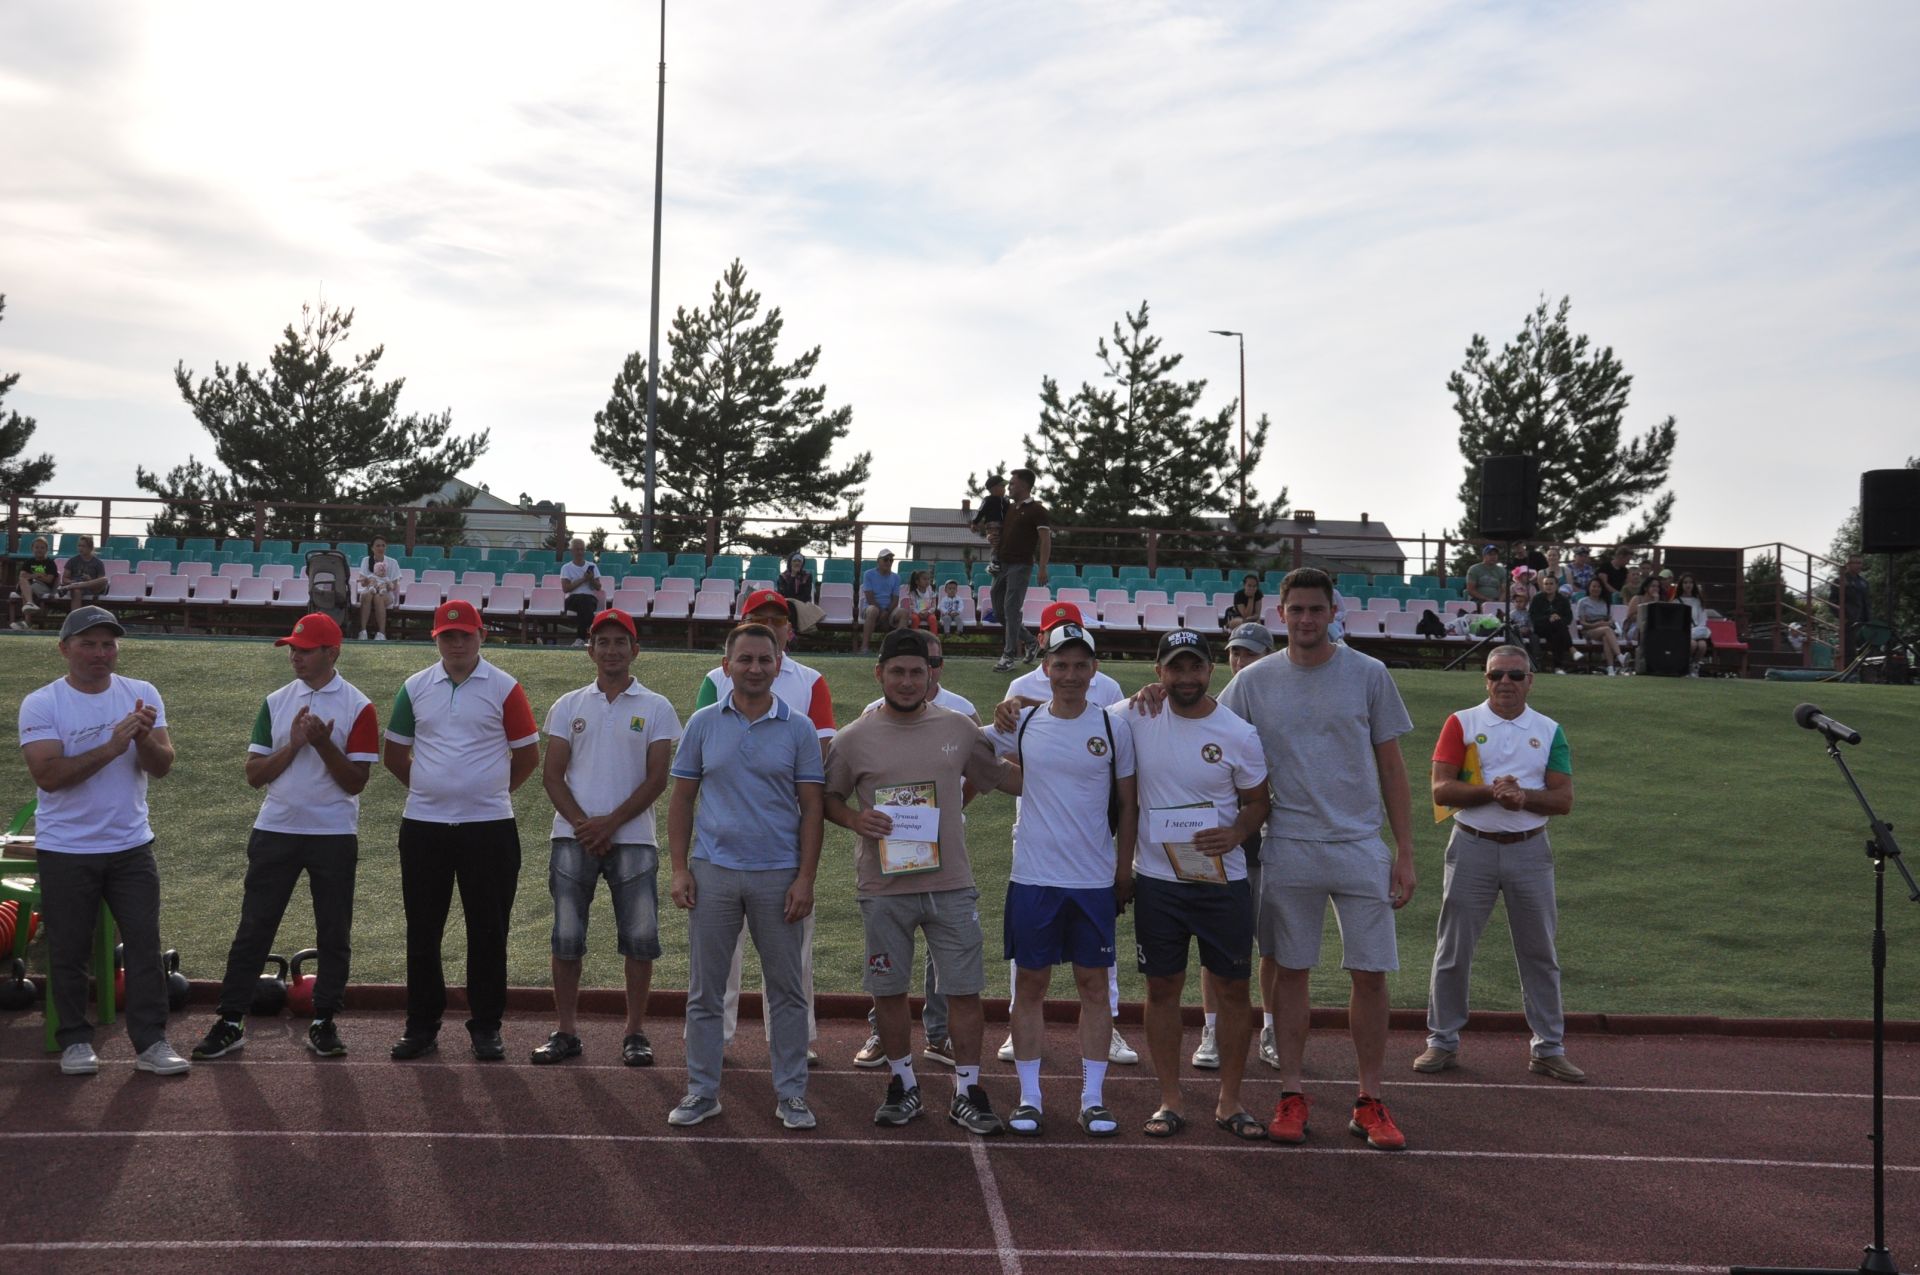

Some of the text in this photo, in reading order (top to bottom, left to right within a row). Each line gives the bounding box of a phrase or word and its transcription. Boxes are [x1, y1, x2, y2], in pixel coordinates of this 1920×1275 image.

[1168, 631, 1198, 641] NEW YORK
[1176, 636, 1192, 645] CITY
